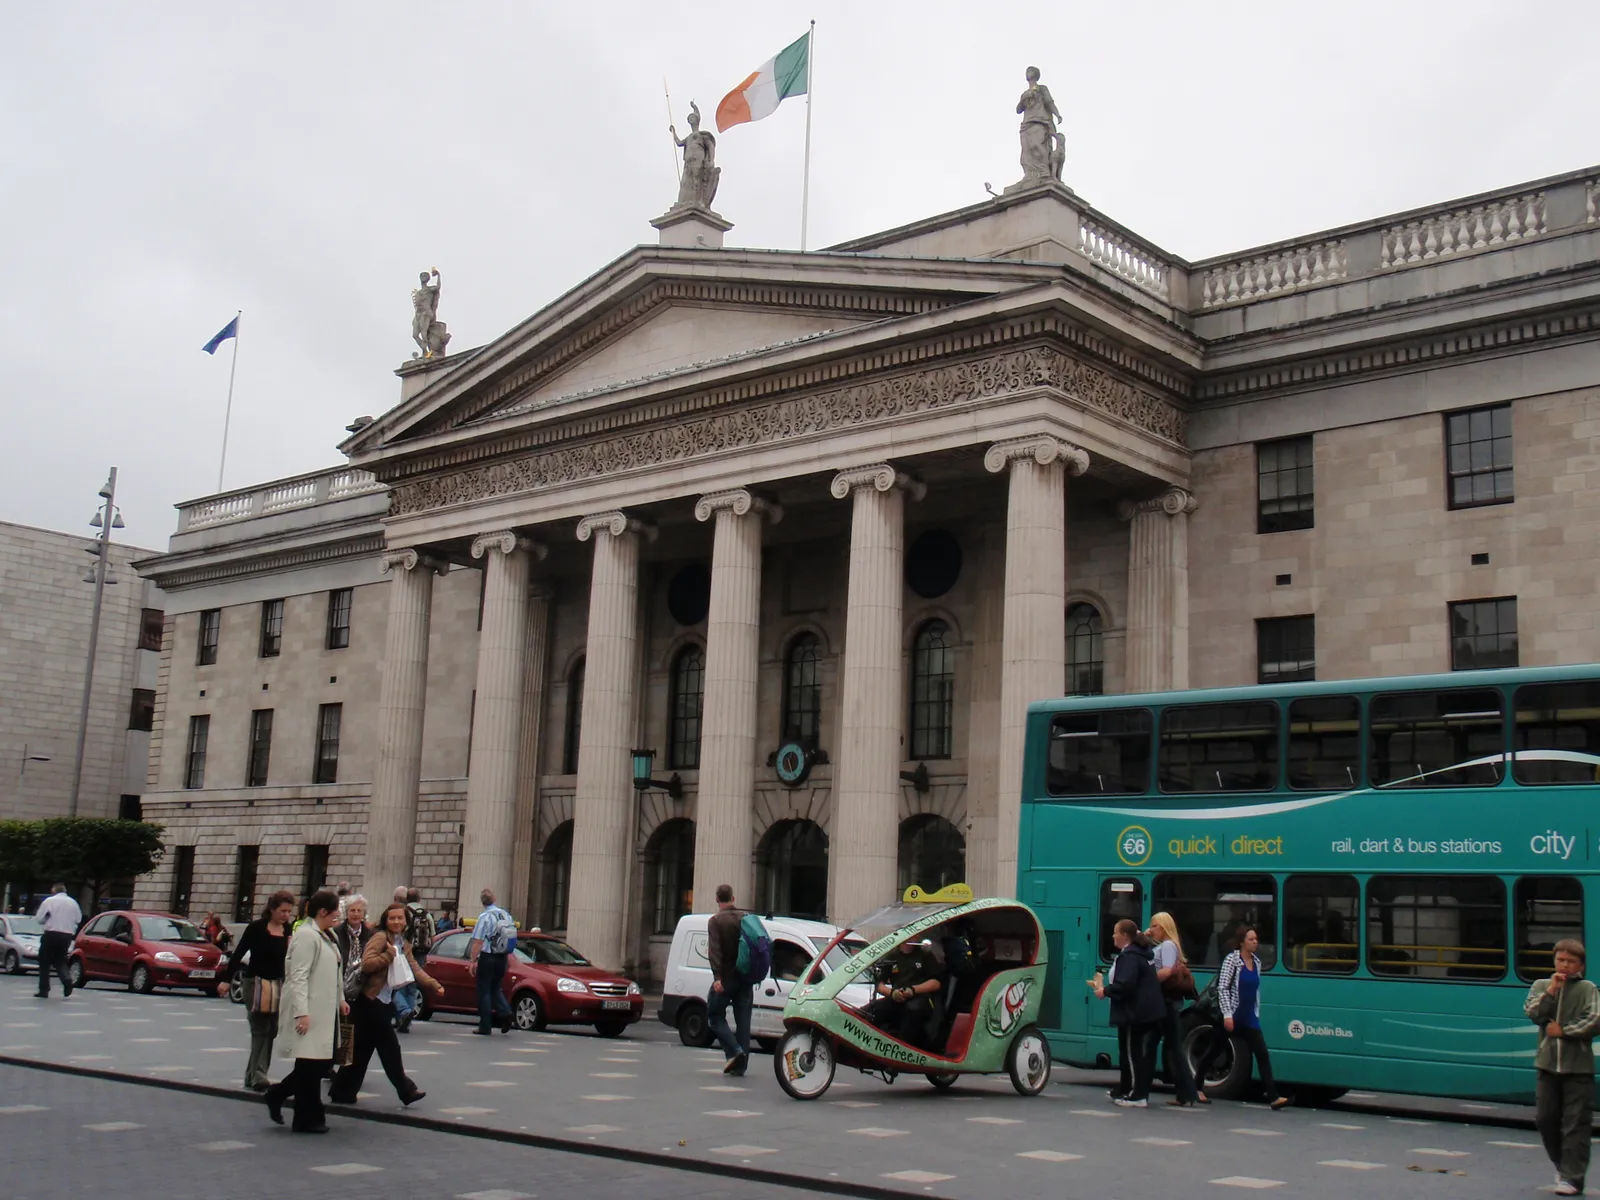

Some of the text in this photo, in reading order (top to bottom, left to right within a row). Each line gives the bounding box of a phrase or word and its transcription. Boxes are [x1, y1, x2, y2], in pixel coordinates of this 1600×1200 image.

[1123, 838, 1145, 855] €6
[1168, 835, 1217, 858] quick
[1231, 834, 1283, 855] direct
[1331, 838, 1502, 855] rail, dart & bus stations
[1530, 830, 1576, 860] city
[844, 957, 865, 975] GET
[865, 935, 896, 959] BEHIND
[903, 924, 921, 936] THE
[922, 912, 950, 929] CLIFFS
[1306, 1025, 1353, 1038] Dublin Bus
